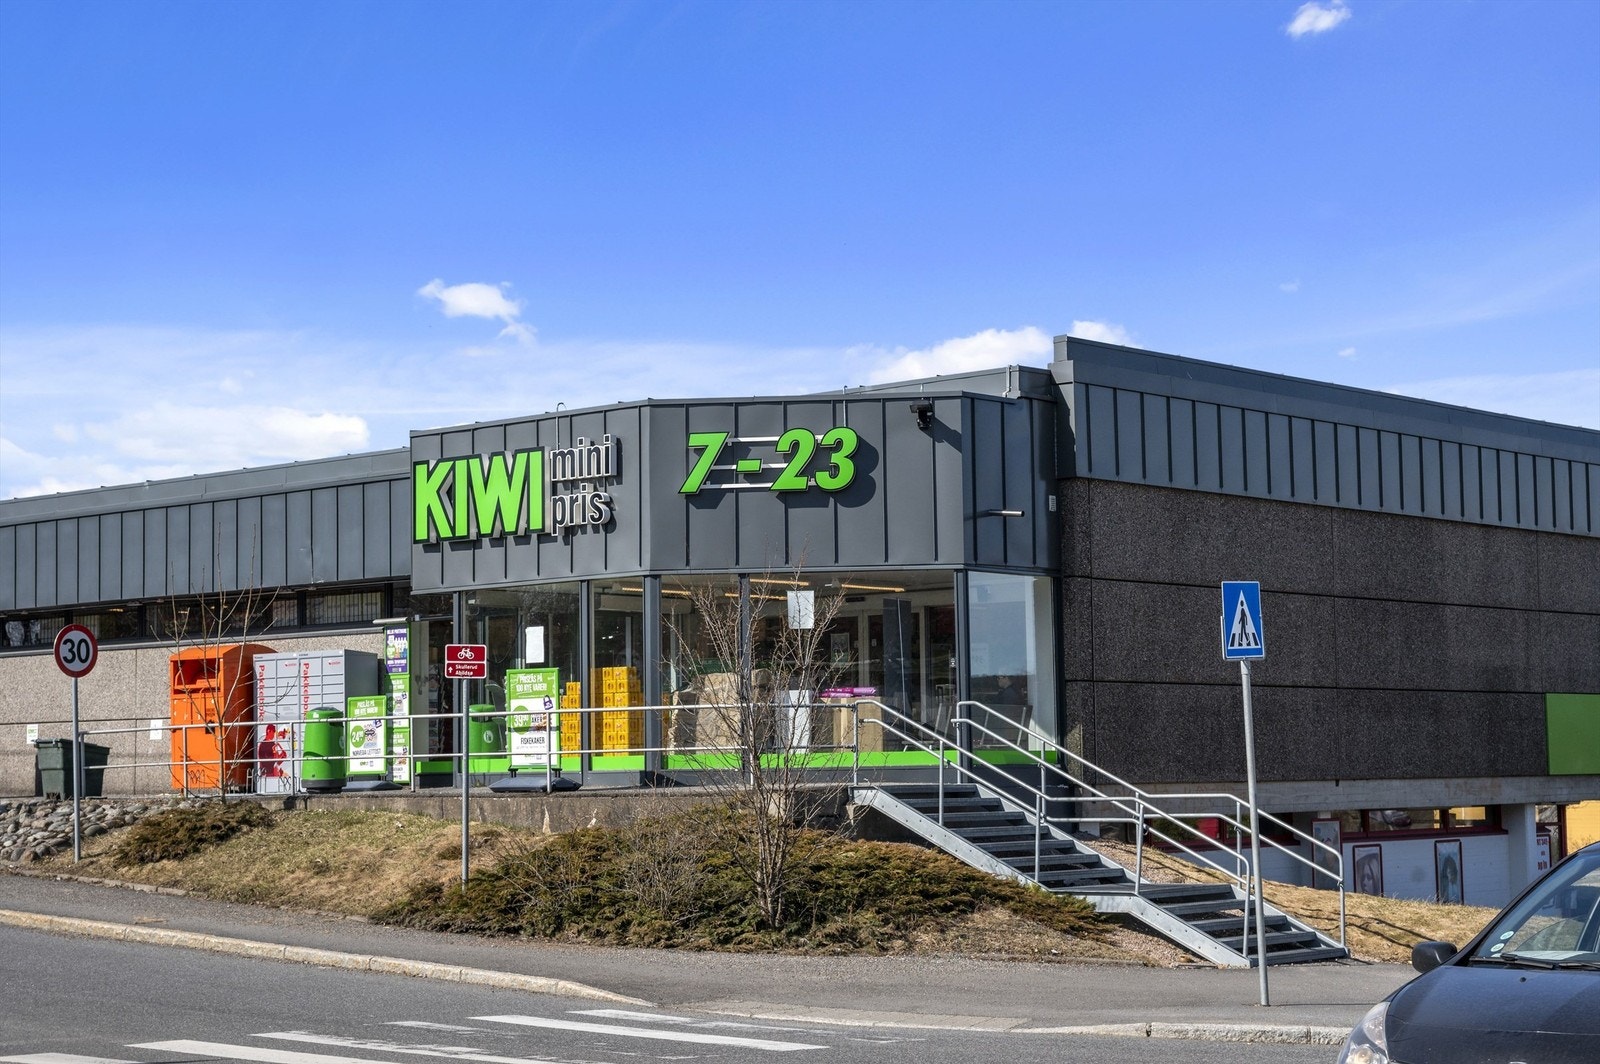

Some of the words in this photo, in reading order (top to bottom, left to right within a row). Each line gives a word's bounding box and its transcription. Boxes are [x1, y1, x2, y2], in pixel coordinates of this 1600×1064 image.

[551, 434, 612, 481] mini
[678, 431, 731, 494] 7
[769, 426, 859, 491] 23
[413, 446, 546, 544] KIWI
[551, 483, 611, 536] pris
[62, 638, 90, 664] 30
